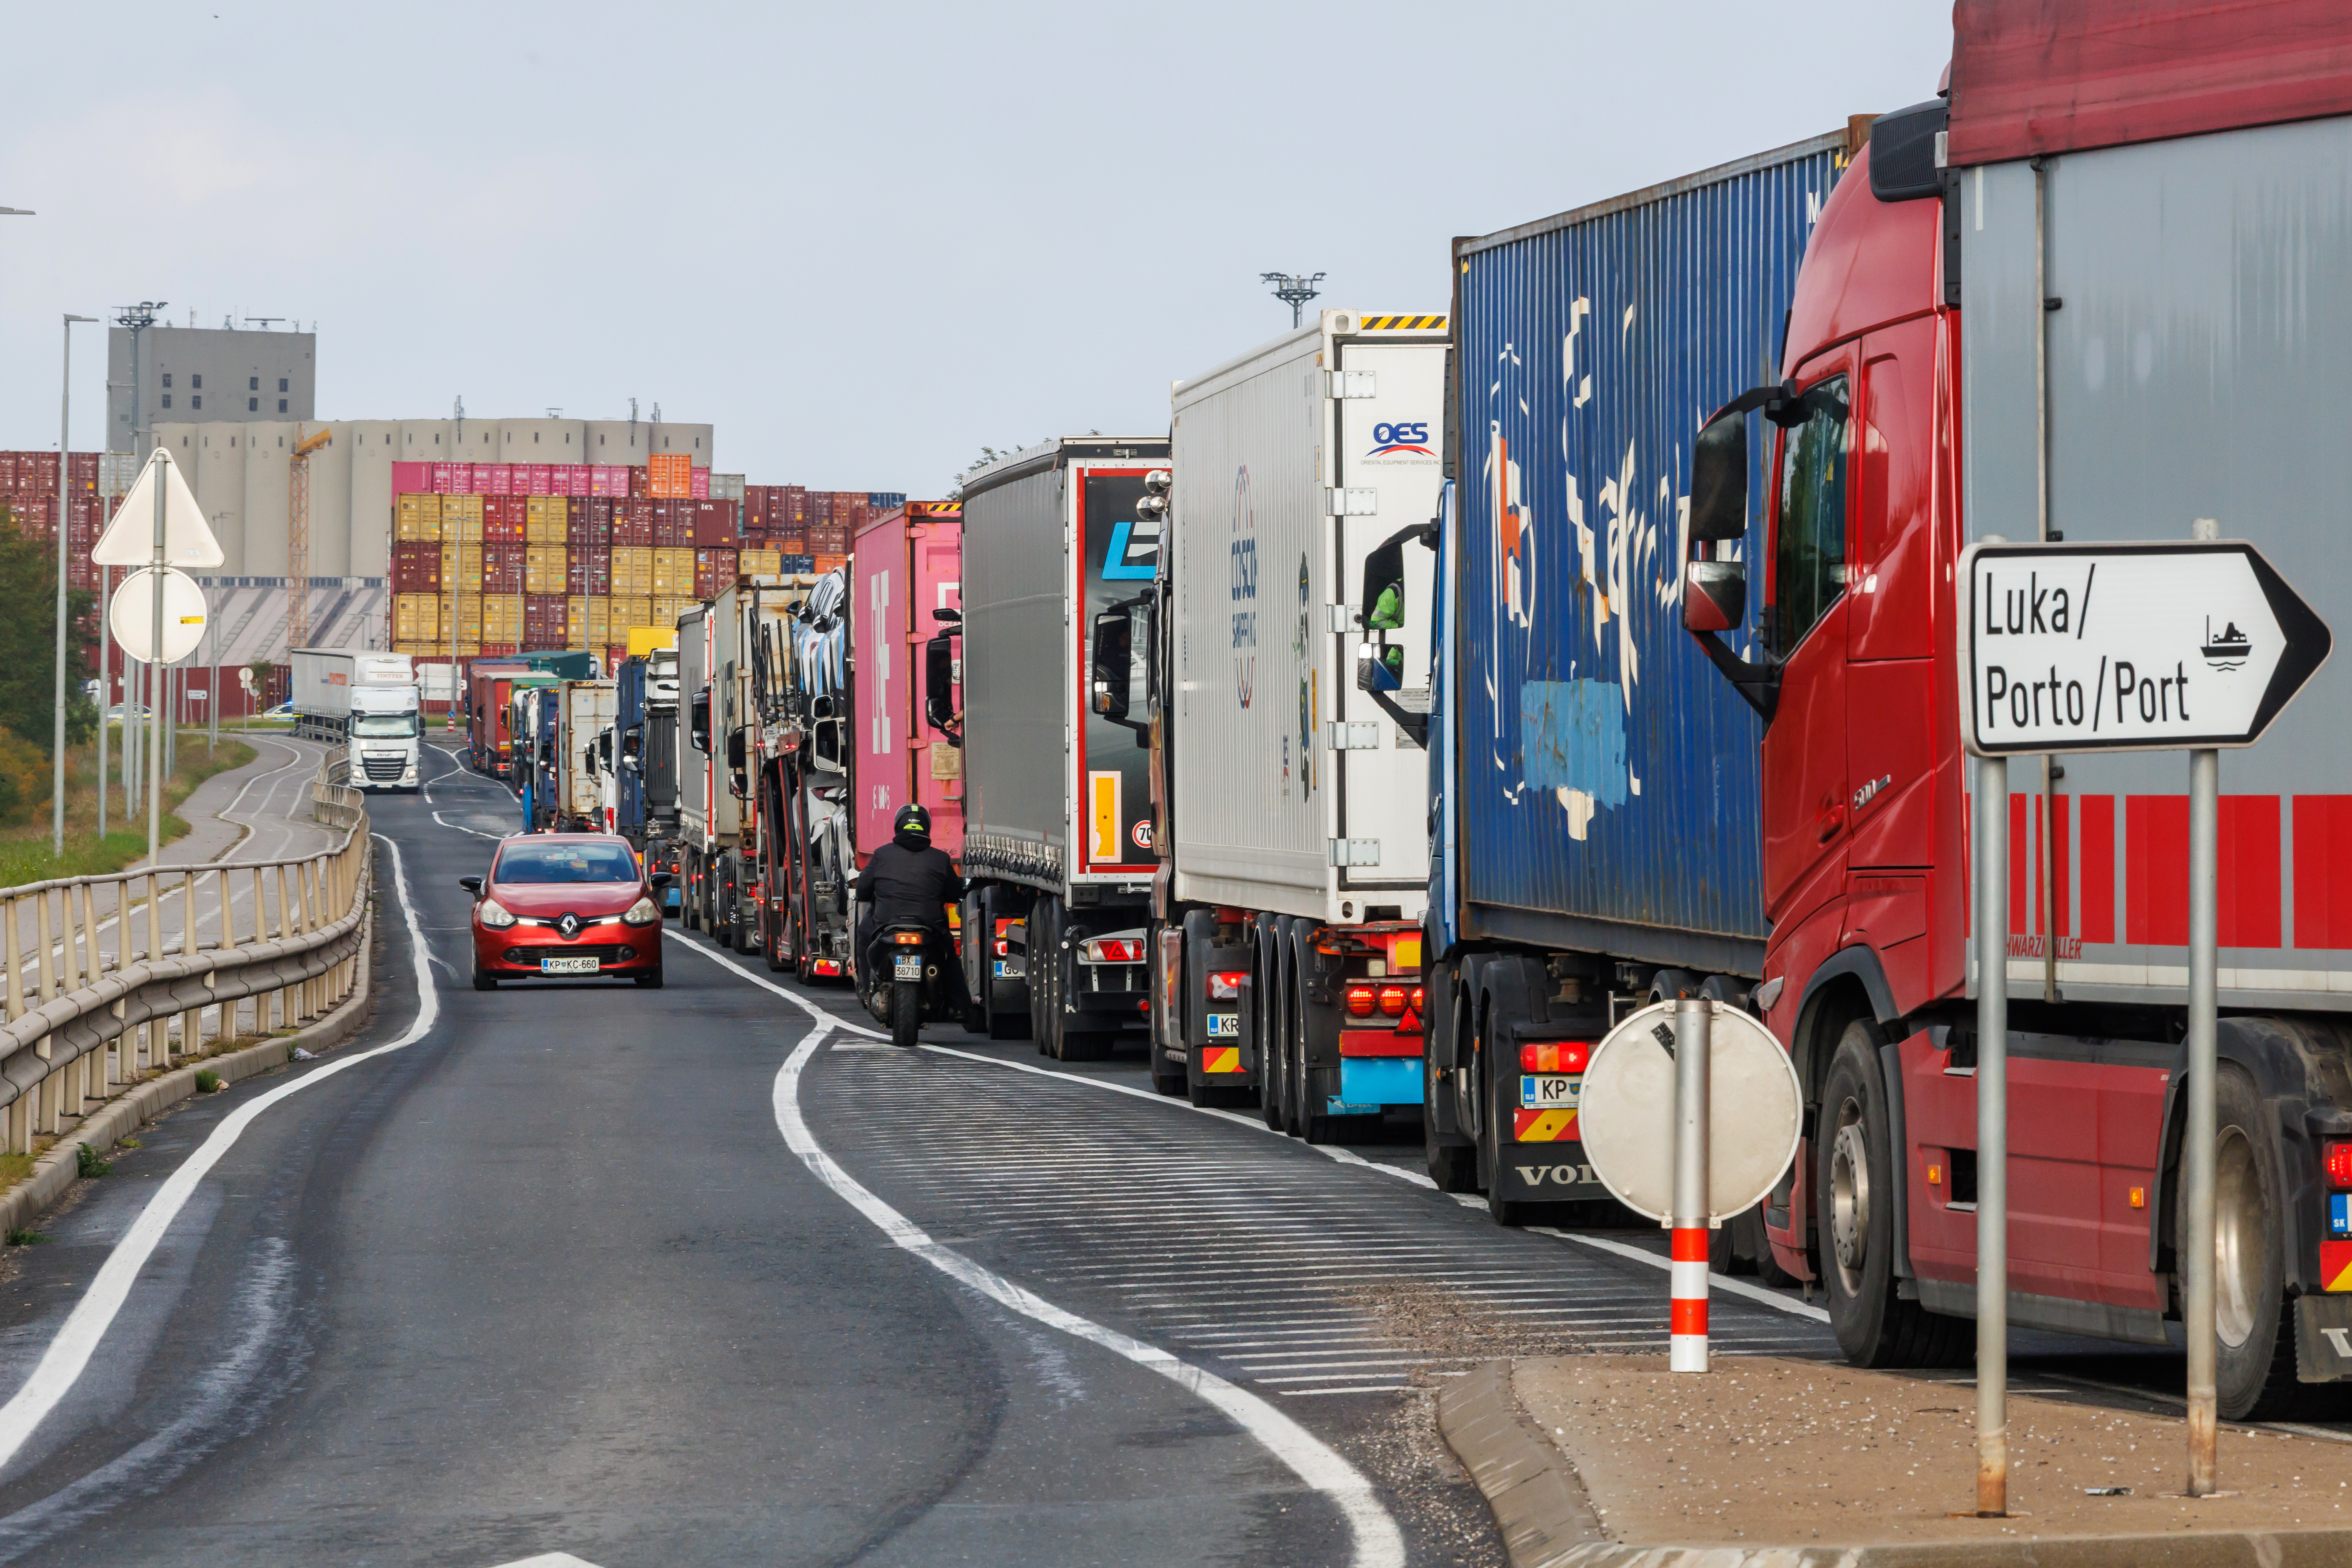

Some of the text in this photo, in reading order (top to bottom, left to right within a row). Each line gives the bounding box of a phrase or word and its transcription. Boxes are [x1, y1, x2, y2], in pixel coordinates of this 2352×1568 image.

[1374, 423, 1428, 444] OES
[1854, 780, 1876, 811] 500
[549, 960, 596, 969] KP KC-660
[896, 966, 920, 976] 38710
[1221, 1018, 1239, 1032] KR
[1542, 1079, 1567, 1099] KP
[2333, 1219, 2345, 1227] SK
